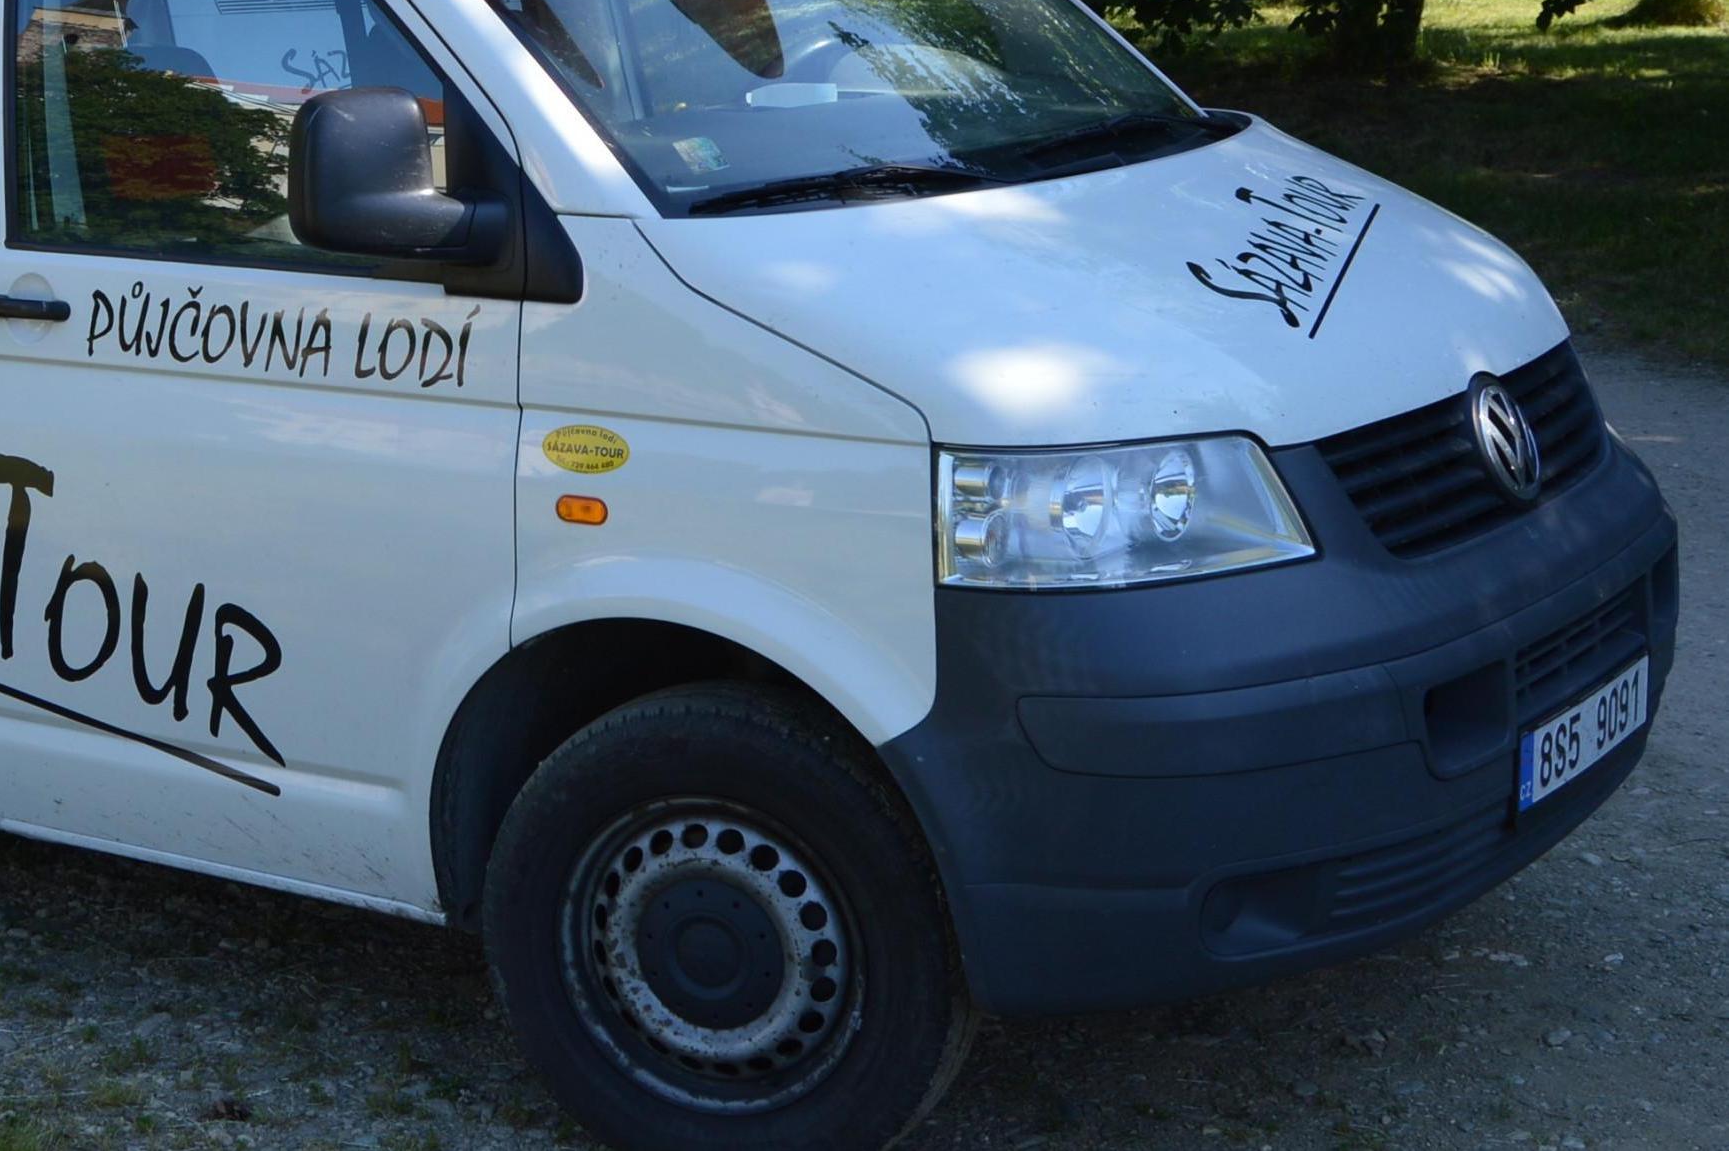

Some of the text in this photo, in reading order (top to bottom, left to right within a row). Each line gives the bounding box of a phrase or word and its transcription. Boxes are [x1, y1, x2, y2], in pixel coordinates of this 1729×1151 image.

[86, 280, 482, 388] PŮJČOVNA LODÍ
[1540, 669, 1639, 788] 8S5 9091
